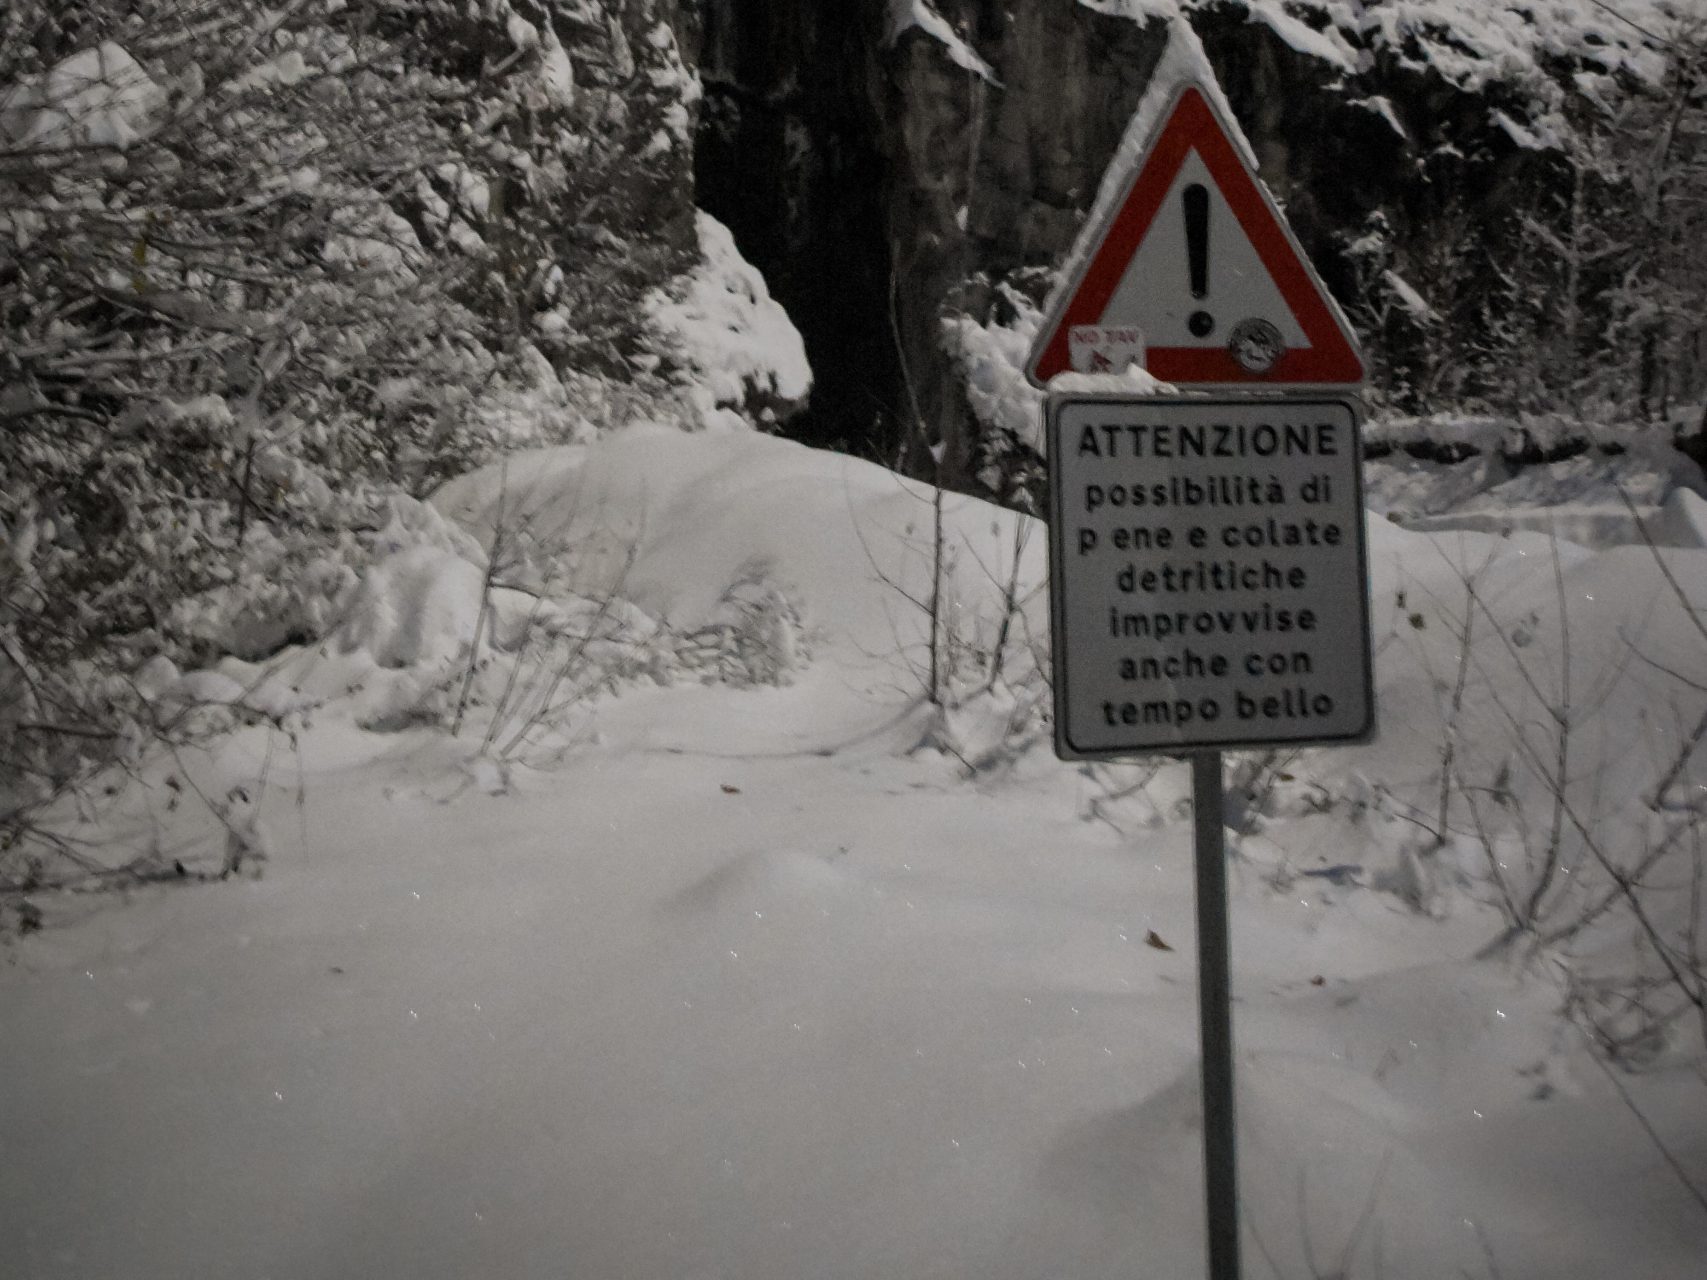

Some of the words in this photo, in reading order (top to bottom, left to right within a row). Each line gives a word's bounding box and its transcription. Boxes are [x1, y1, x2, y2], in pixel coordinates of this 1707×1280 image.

[1077, 423, 1339, 459] ATTENZIONE
[1084, 474, 1286, 514] possibilità
[1298, 473, 1332, 505] di
[1185, 525, 1209, 550] e
[1220, 516, 1342, 549] colate
[1116, 559, 1307, 595] detritiche
[1109, 602, 1318, 642] improvvise
[1118, 647, 1230, 682] anche
[1243, 651, 1314, 677] con
[1100, 697, 1222, 732] tempo
[1234, 687, 1335, 721] bello
